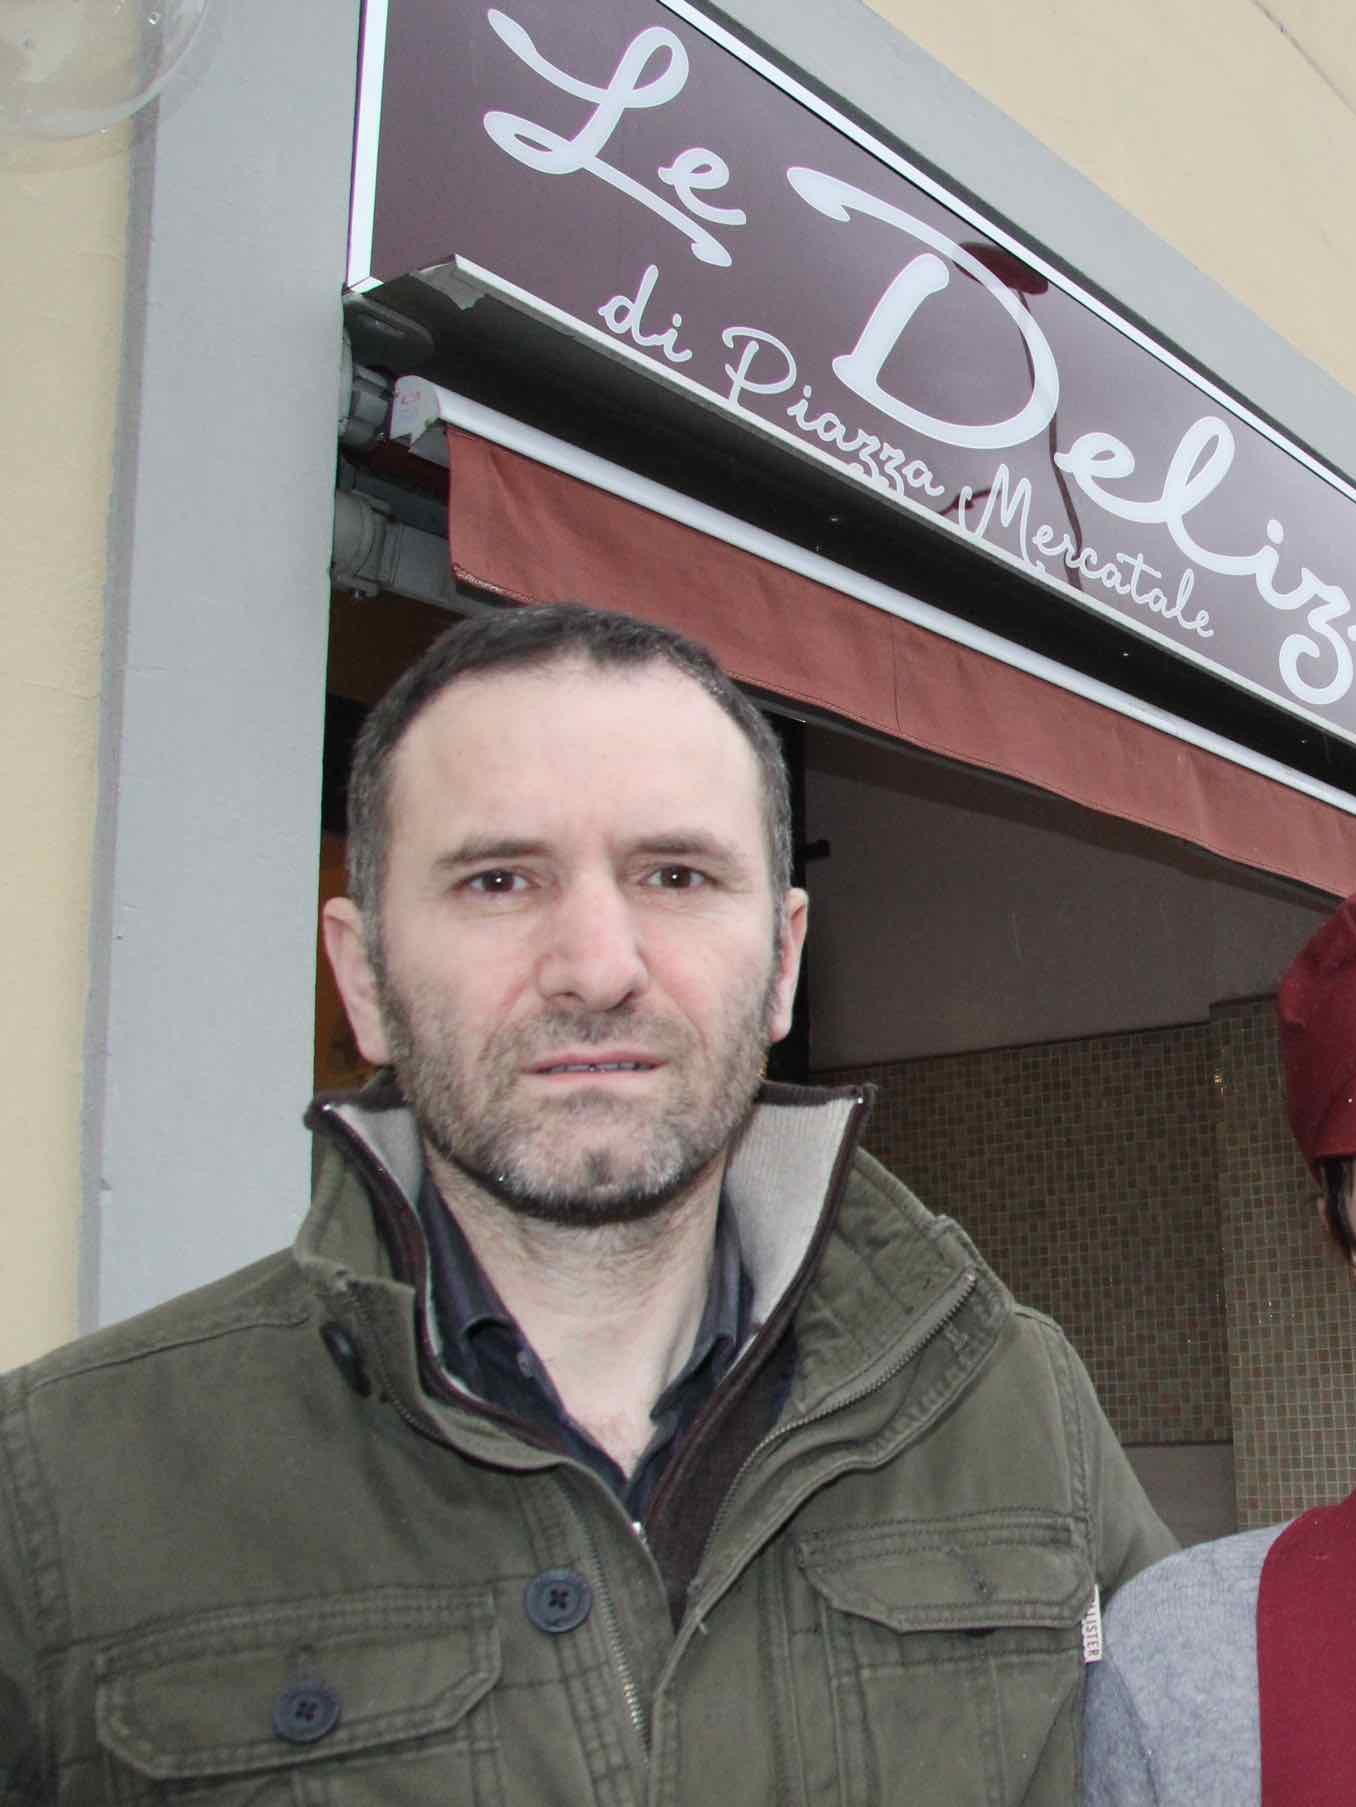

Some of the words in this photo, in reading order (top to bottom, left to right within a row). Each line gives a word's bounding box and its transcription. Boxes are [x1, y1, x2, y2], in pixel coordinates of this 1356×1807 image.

[483, 8, 747, 266] Le
[599, 265, 692, 363] di
[722, 326, 945, 497] Piazza
[958, 464, 1213, 637] Mercatale
